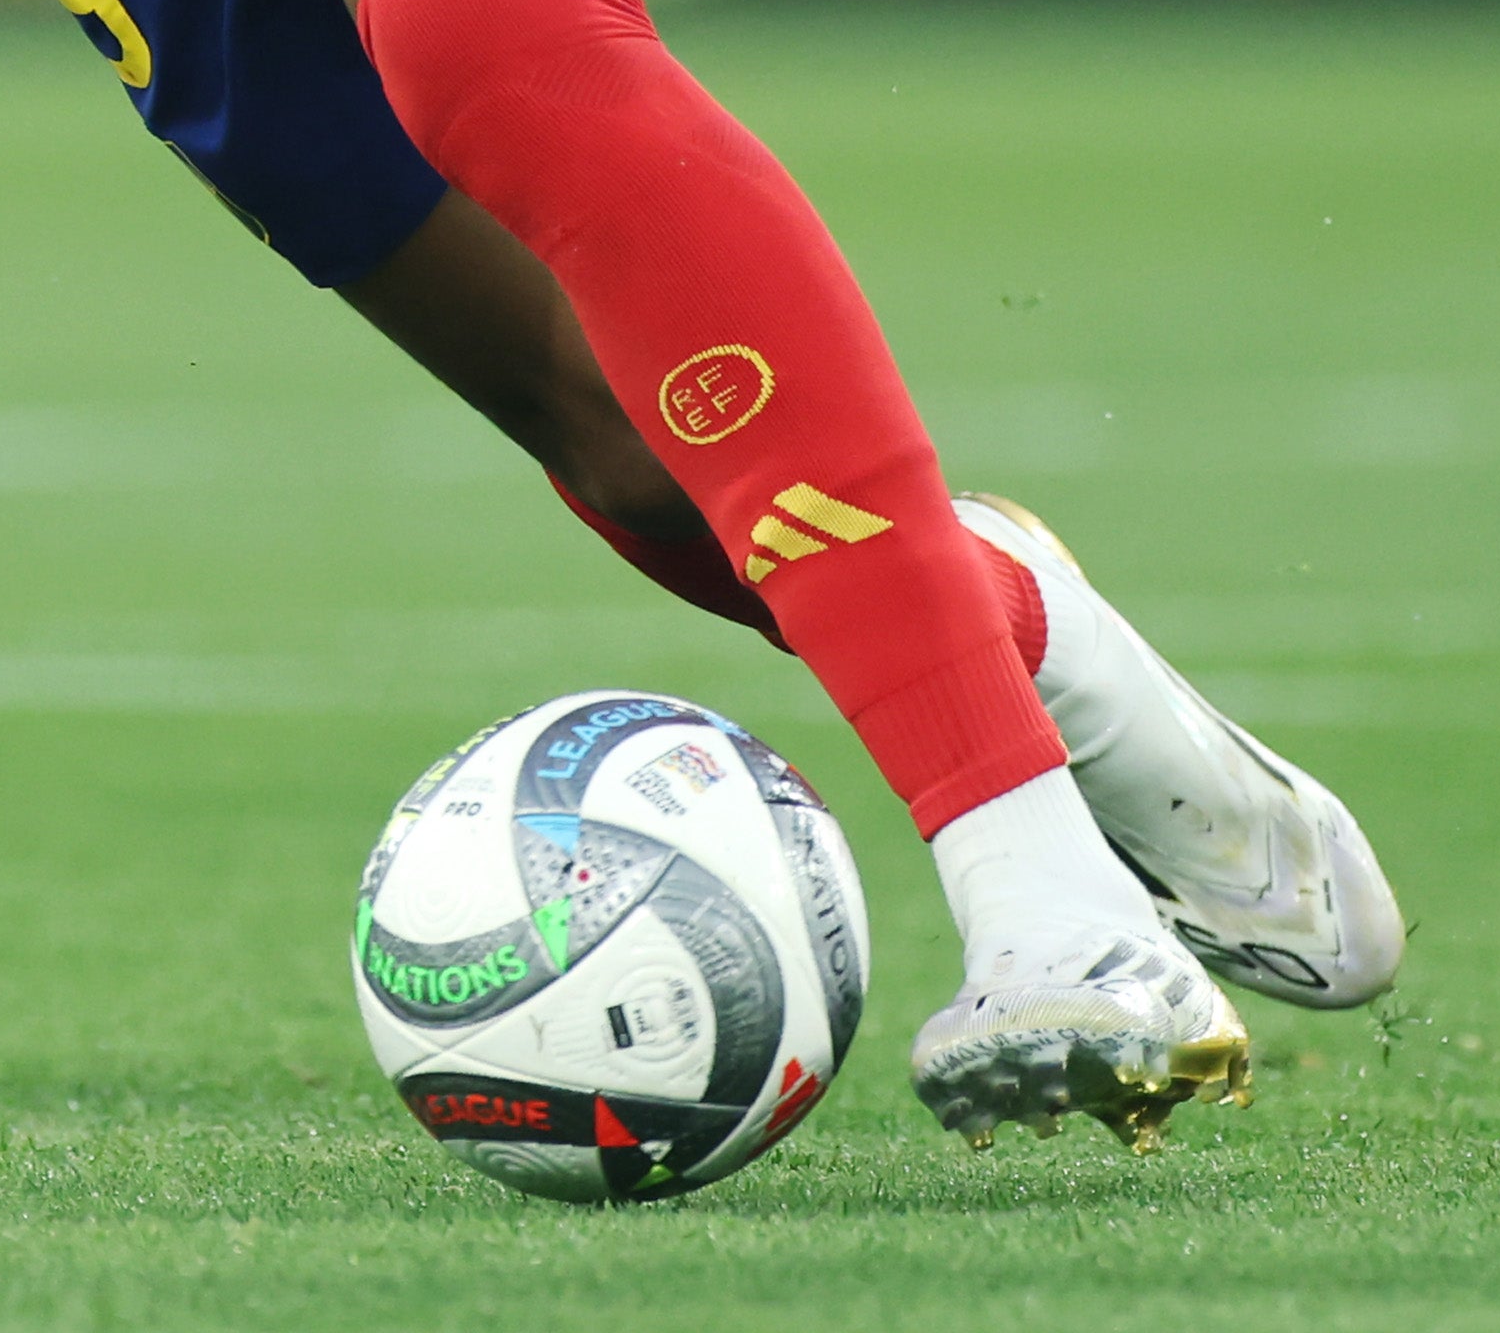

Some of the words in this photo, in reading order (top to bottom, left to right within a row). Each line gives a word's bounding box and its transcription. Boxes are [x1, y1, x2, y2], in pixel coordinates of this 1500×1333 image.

[536, 701, 680, 780] LEAGUE
[367, 941, 530, 1005] NATIONS
[414, 1093, 553, 1131] EAGUE
